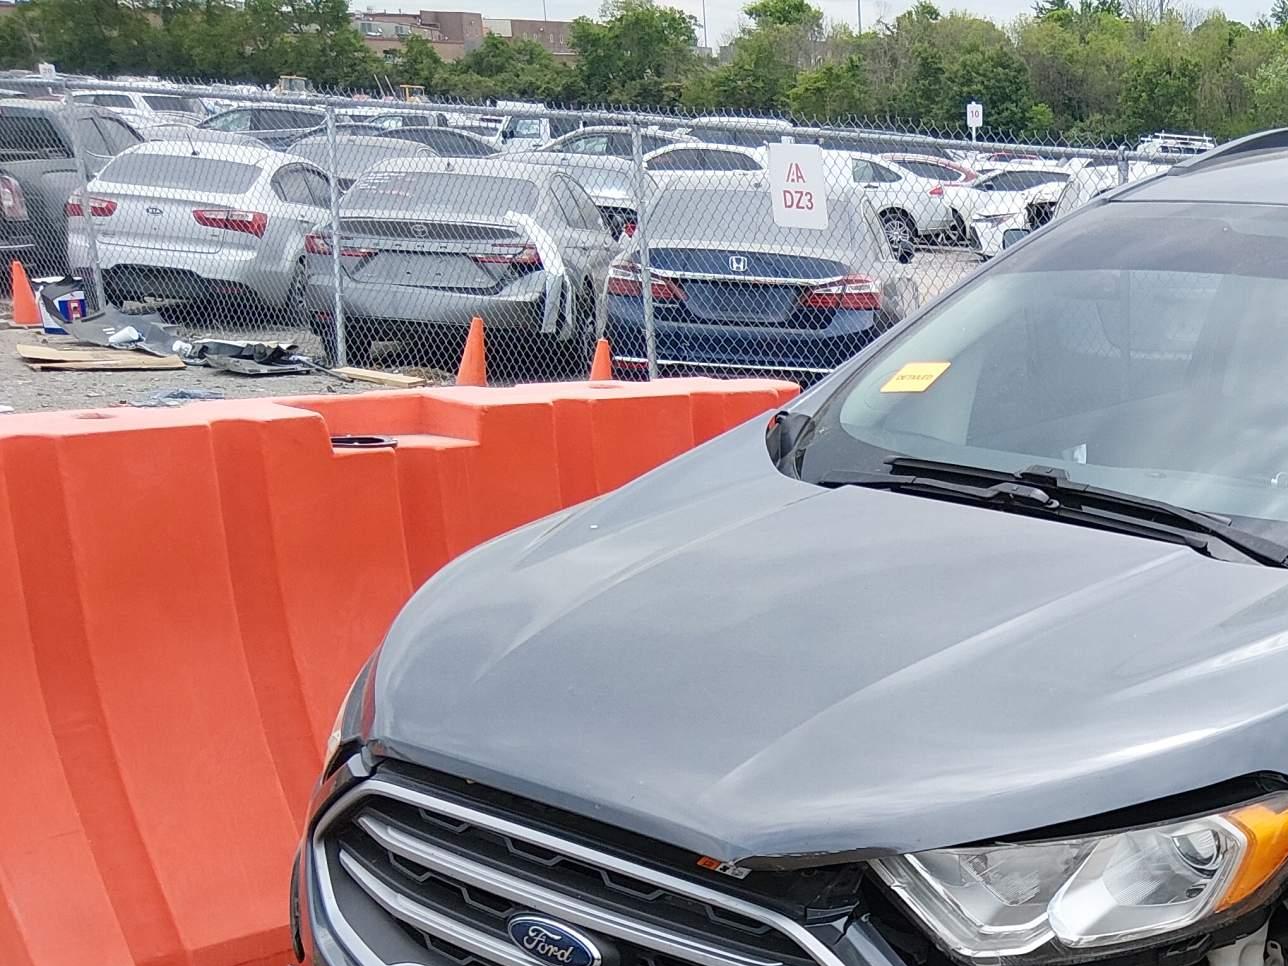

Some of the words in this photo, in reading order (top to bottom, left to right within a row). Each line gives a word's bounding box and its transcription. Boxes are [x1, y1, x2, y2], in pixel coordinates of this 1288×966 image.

[970, 110, 980, 118] 10
[783, 190, 814, 210] DZ3
[523, 925, 575, 963] Ford
